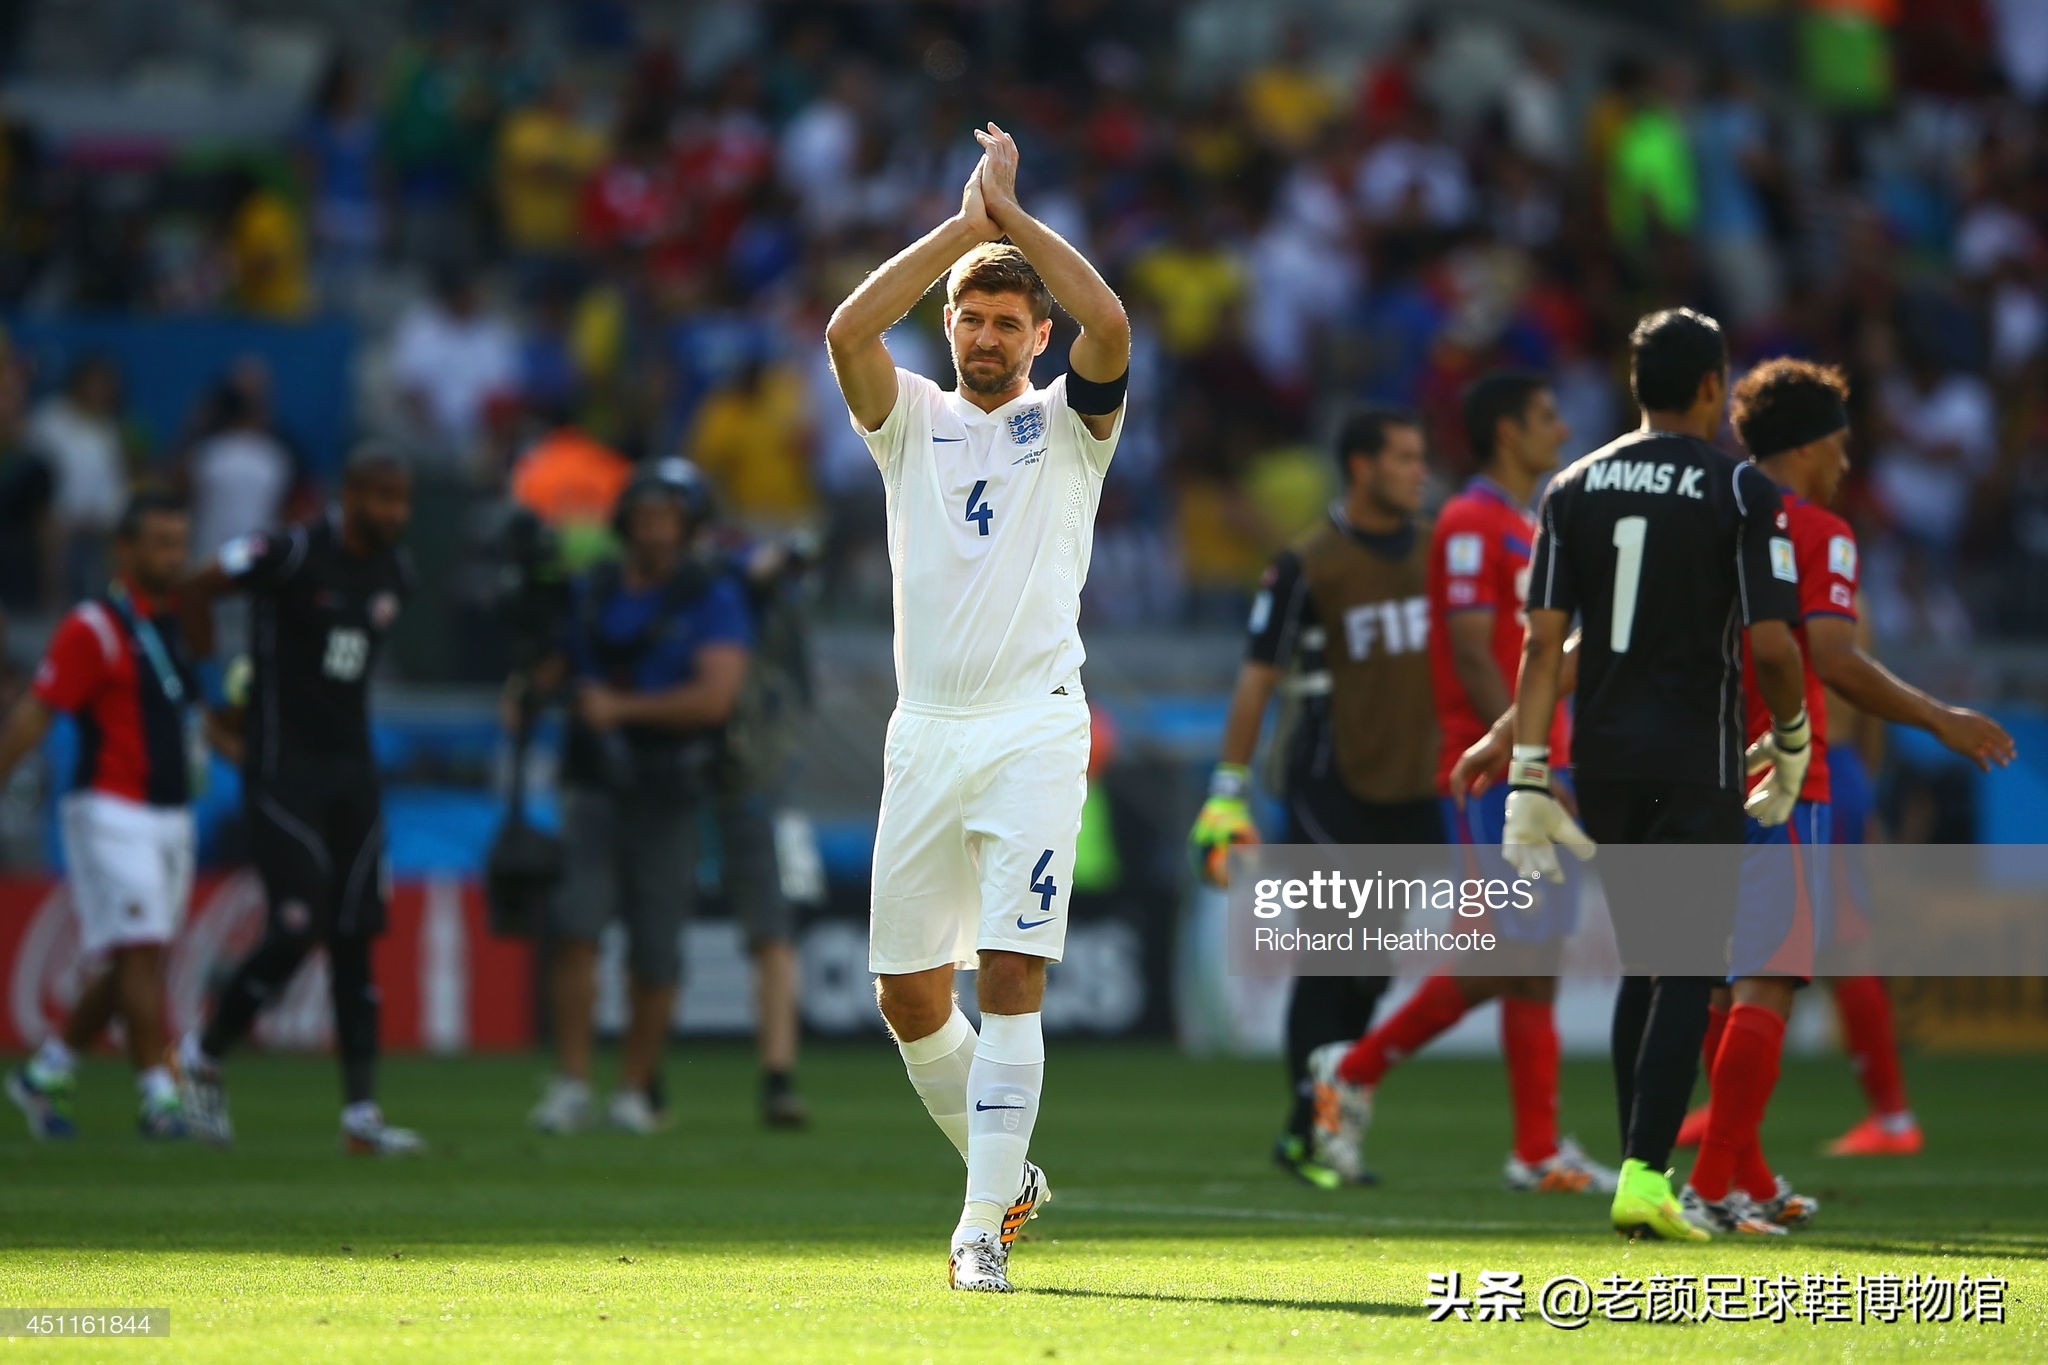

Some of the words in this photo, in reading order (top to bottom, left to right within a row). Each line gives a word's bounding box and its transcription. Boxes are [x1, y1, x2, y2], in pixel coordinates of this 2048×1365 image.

[965, 480, 993, 536] 4
[1584, 460, 1675, 494] NAVAS
[1677, 465, 1704, 499] K.
[1611, 515, 1647, 653] 1
[1345, 597, 1430, 661] FIF
[1030, 849, 1057, 911] 4
